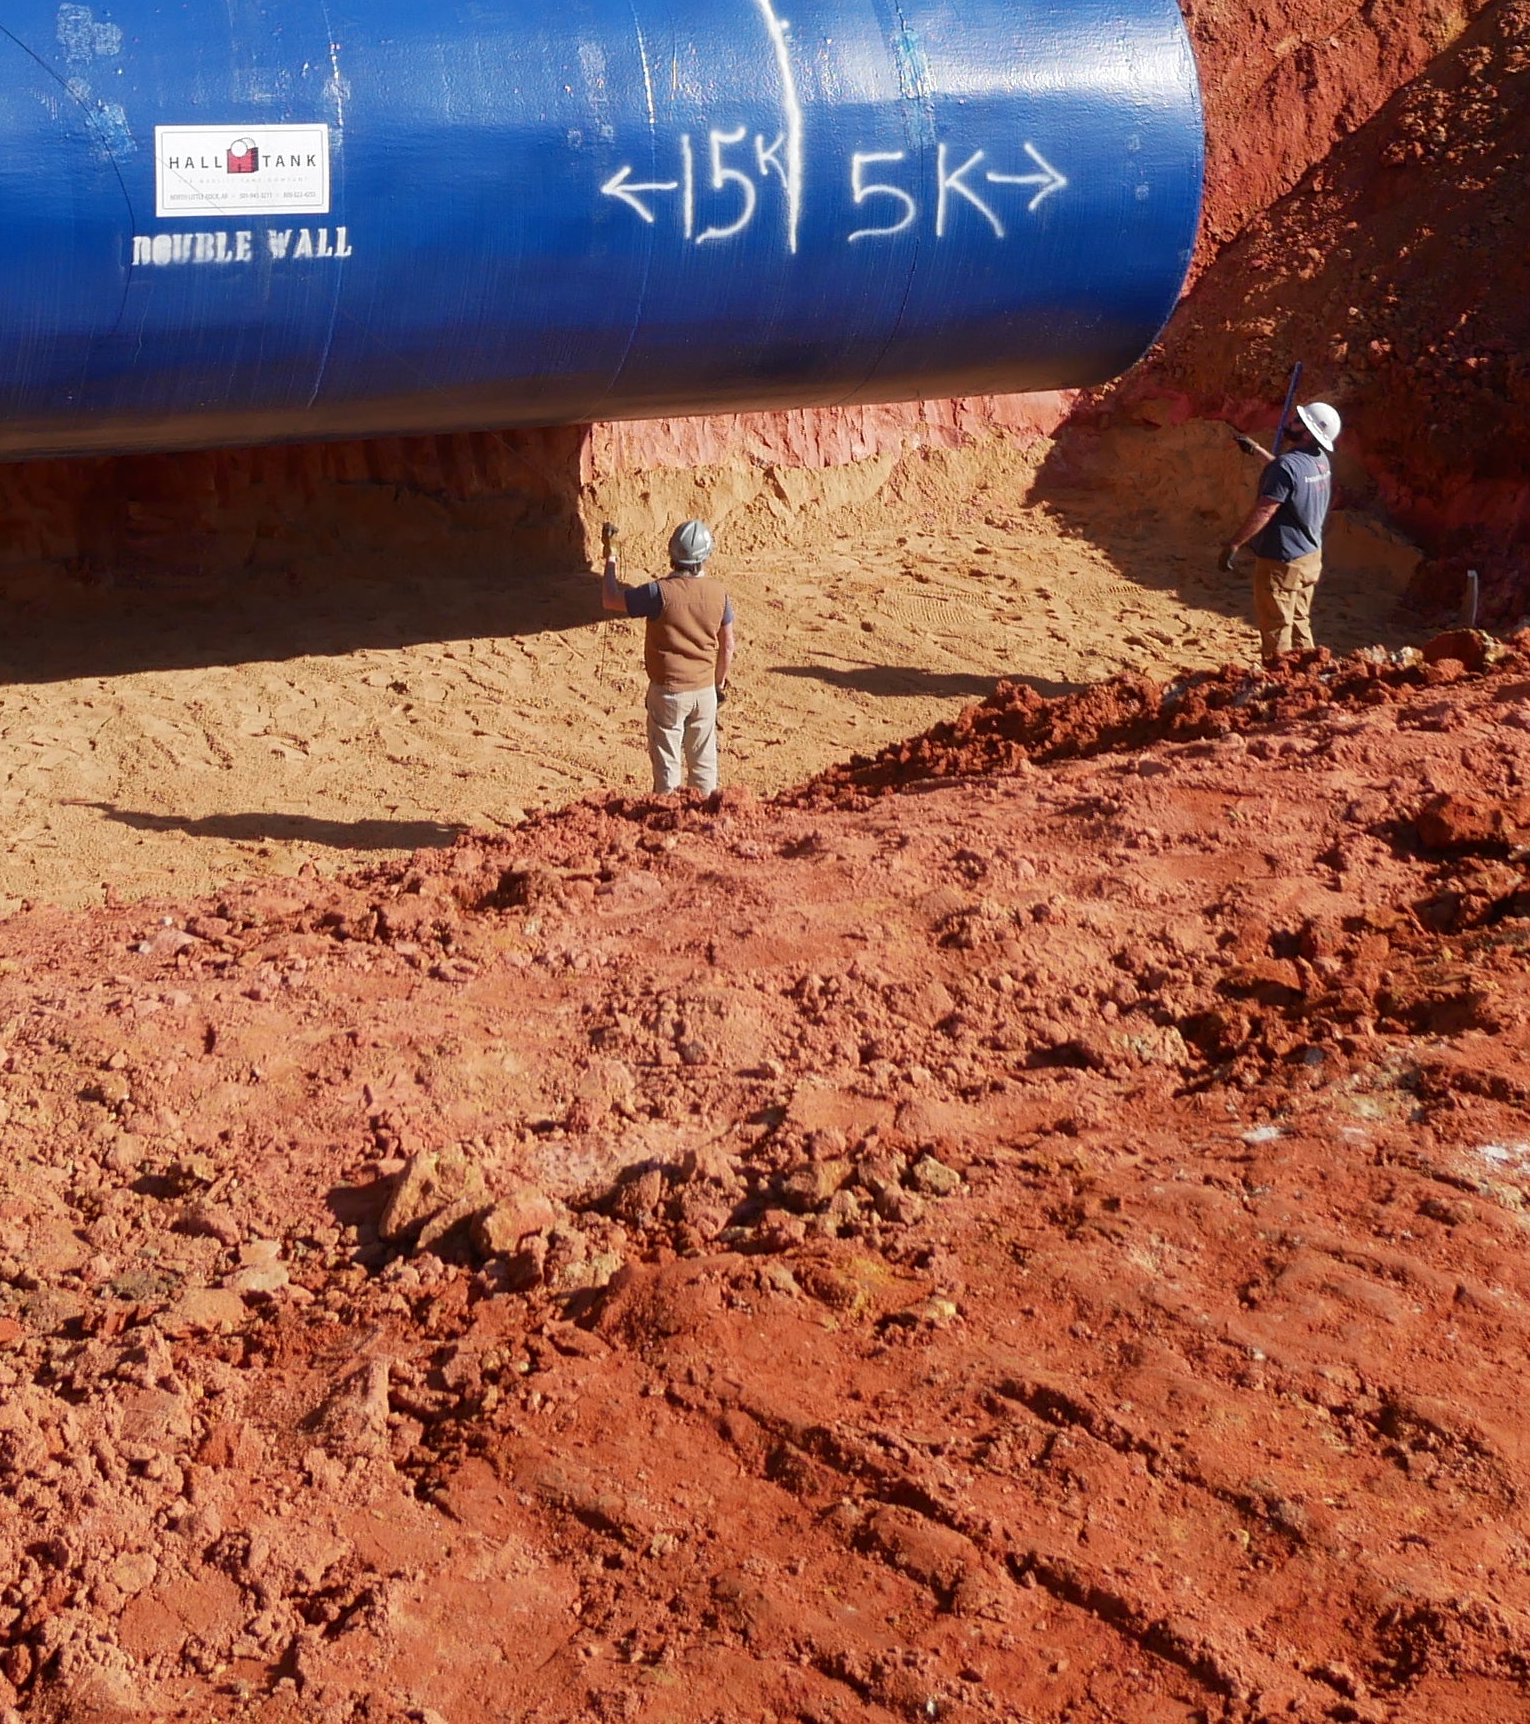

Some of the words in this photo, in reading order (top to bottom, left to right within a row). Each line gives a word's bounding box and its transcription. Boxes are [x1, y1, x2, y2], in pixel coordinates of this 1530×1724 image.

[169, 156, 222, 169] HALL
[262, 154, 317, 168] TANK
[132, 231, 252, 266] DOUBLE
[268, 226, 352, 259] WALL
